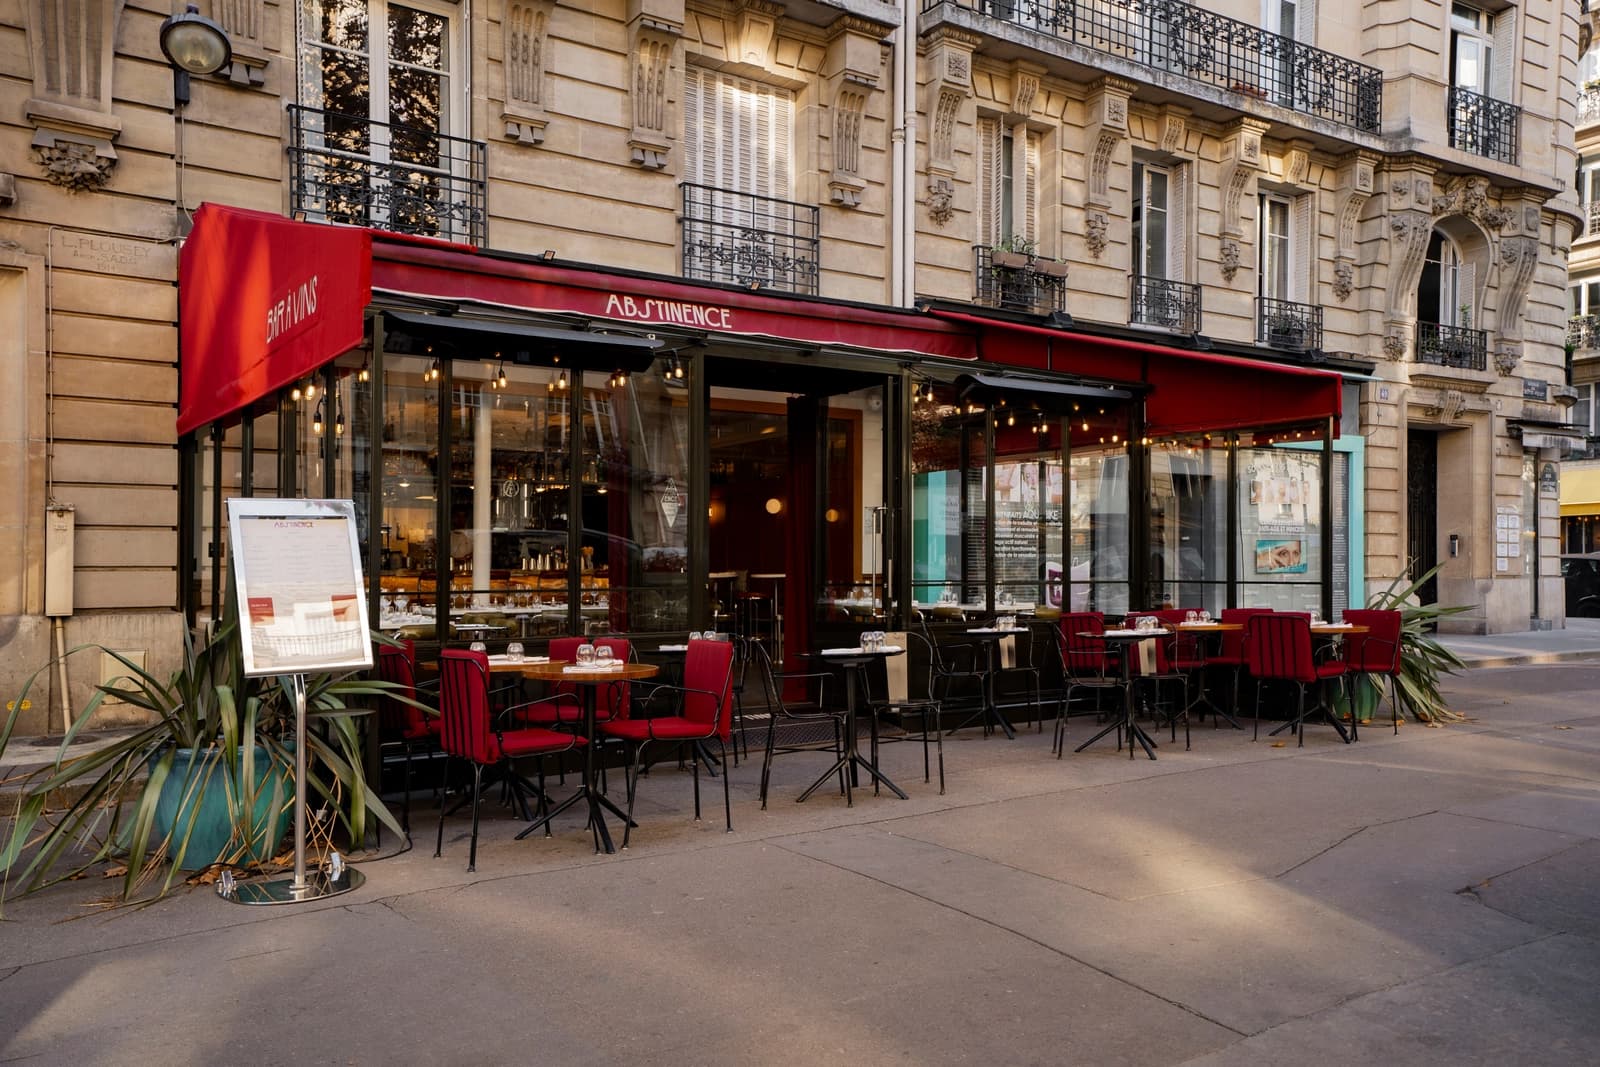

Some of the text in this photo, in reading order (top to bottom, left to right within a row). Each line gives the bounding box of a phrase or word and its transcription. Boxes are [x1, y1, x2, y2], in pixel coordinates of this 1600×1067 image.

[266, 299, 285, 345] BAR
[292, 274, 319, 324] VINS
[605, 294, 732, 329] ABSTINENCE
